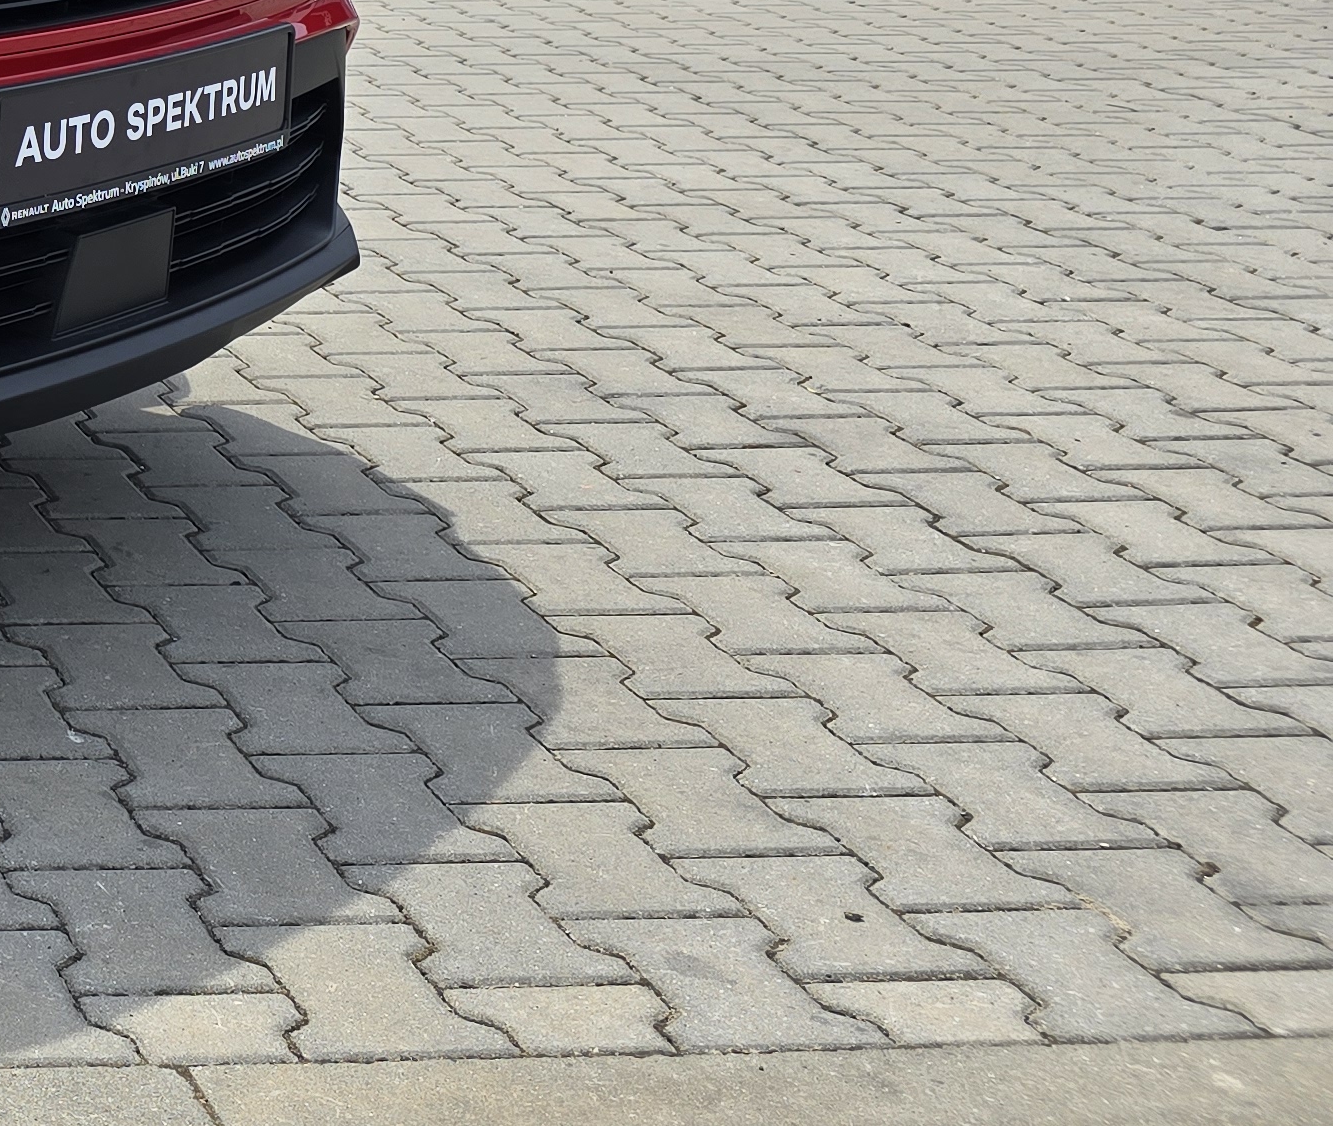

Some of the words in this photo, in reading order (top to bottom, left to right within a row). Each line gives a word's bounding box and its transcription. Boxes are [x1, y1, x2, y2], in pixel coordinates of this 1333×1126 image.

[14, 109, 116, 168] AUTO
[126, 66, 278, 142] SPEKTRUM
[11, 203, 50, 221] RENAULT
[51, 196, 75, 214] Auto
[75, 185, 120, 209] Spektrum
[125, 171, 171, 196] Kryspinów,
[199, 161, 205, 174] 7
[208, 134, 284, 172] www.autospektrum.pl
